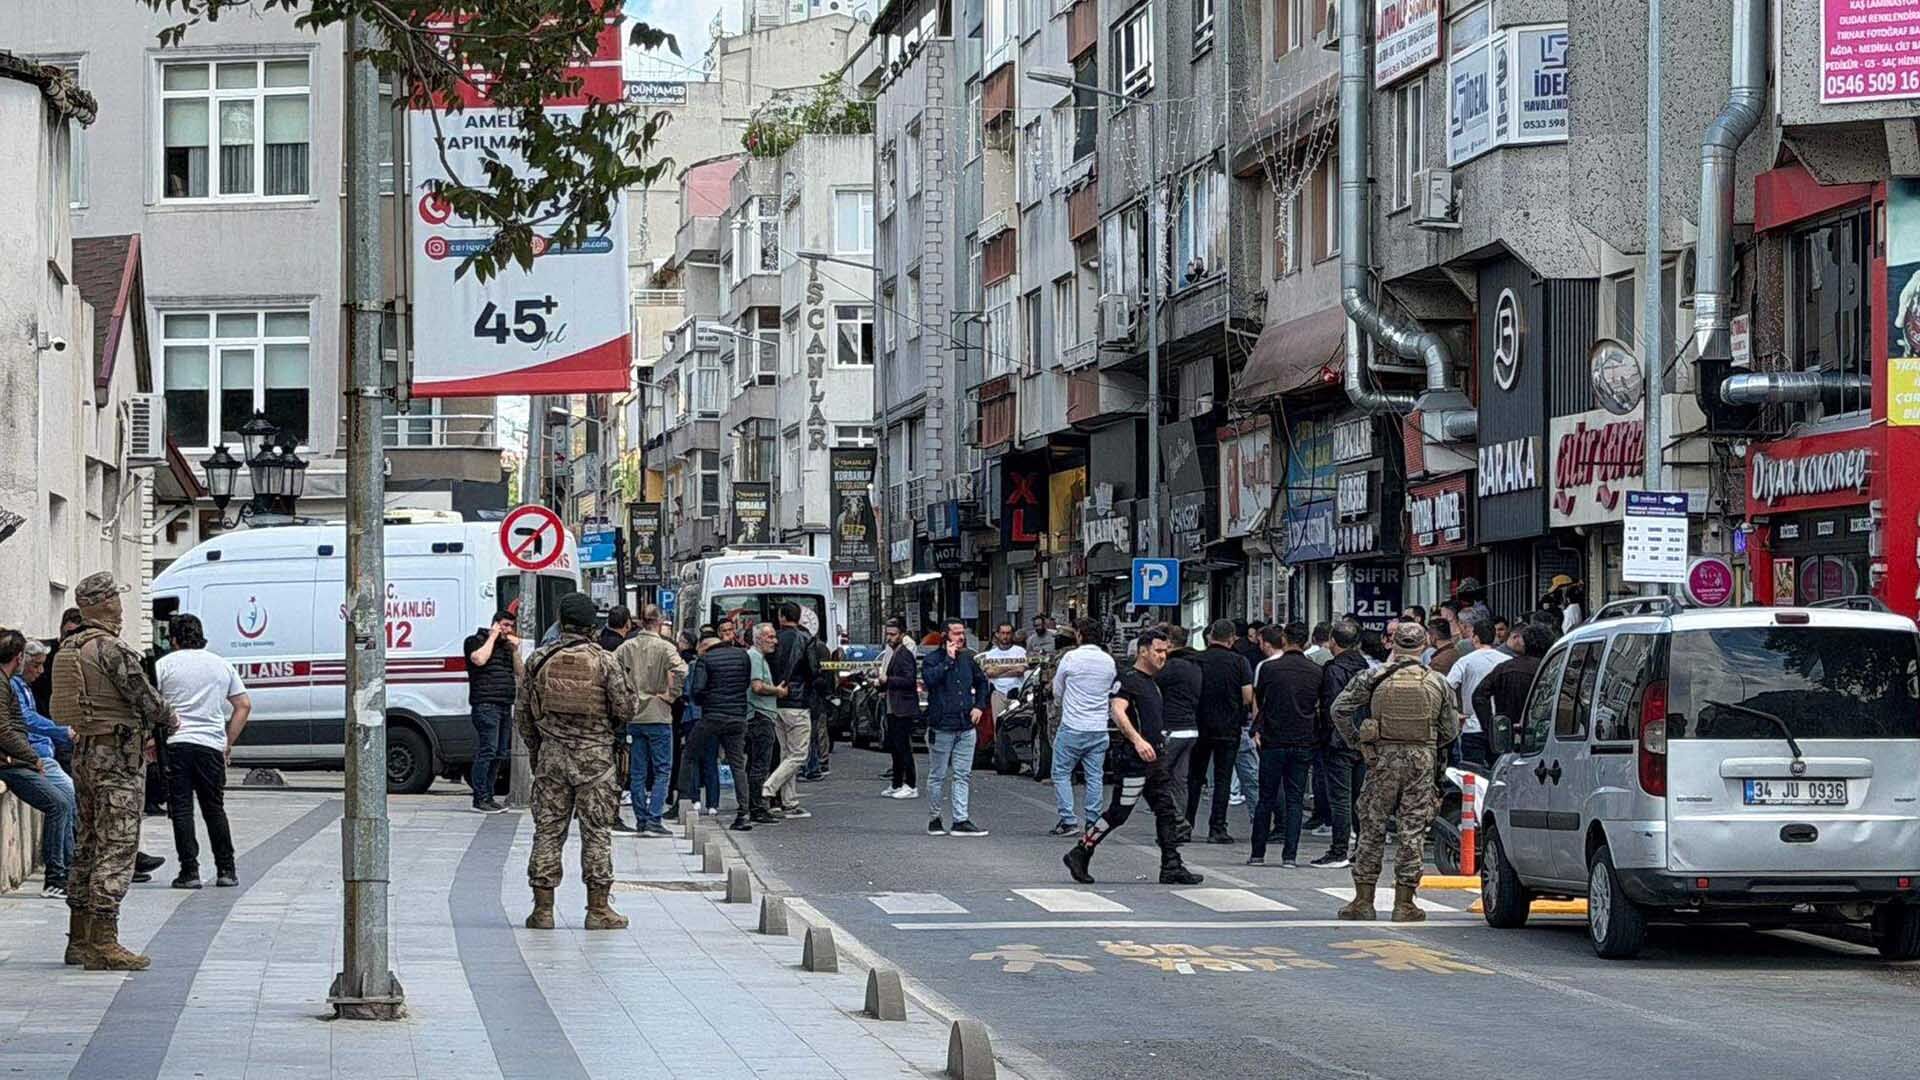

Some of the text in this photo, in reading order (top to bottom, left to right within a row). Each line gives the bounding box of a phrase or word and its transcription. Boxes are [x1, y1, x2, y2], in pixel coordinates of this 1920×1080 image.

[1827, 70, 1919, 94] 0546 509 16
[1523, 118, 1566, 129] 0533 598
[1478, 436, 1536, 497] BARAKA
[723, 573, 810, 588] AMBULANS
[1143, 563, 1168, 600] P
[384, 596, 435, 618] AKANLIĞI
[1357, 600, 1398, 617] 2.EL
[384, 620, 412, 649] 12
[1755, 782, 1844, 799] 34 JU 0936
